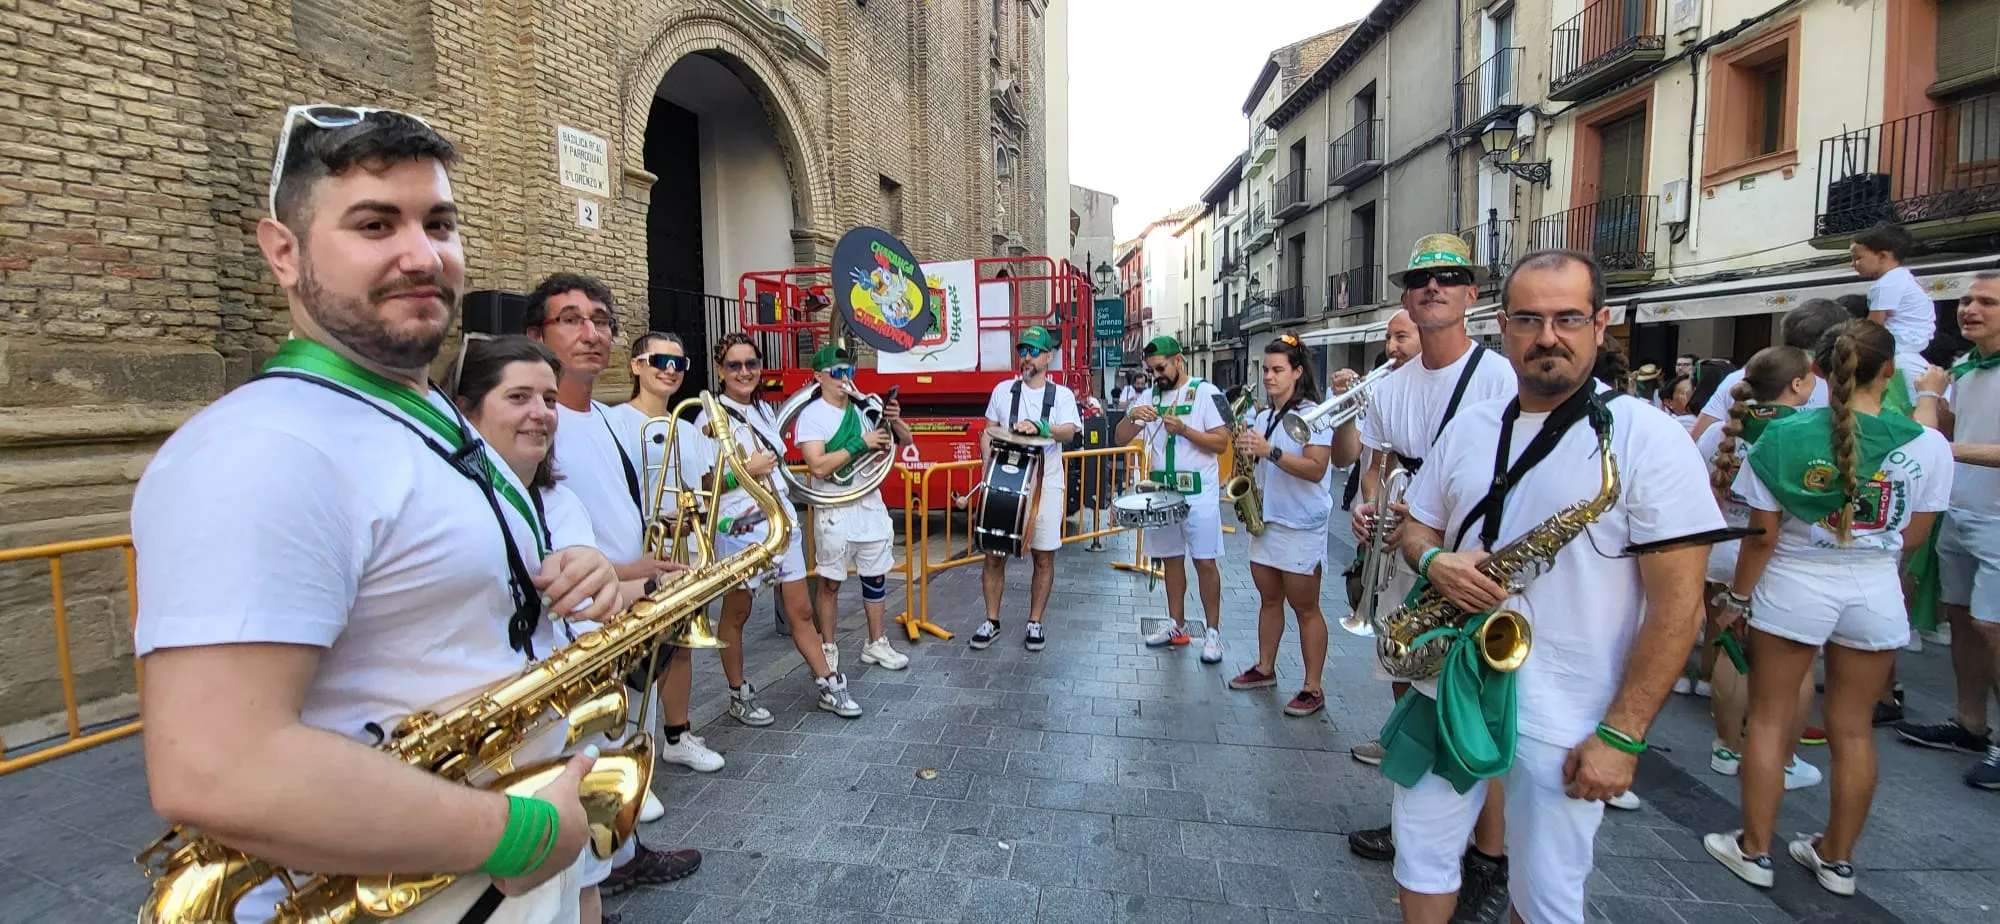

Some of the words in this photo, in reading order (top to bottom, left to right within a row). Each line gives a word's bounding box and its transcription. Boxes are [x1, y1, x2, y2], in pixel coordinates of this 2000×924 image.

[563, 131, 588, 148] BASILICA
[589, 141, 603, 154] REAL
[563, 144, 568, 154] Y
[570, 146, 604, 166] PARROQUIAL
[581, 162, 589, 174] DE
[585, 206, 593, 222] 2
[870, 240, 914, 276] CHARANGA
